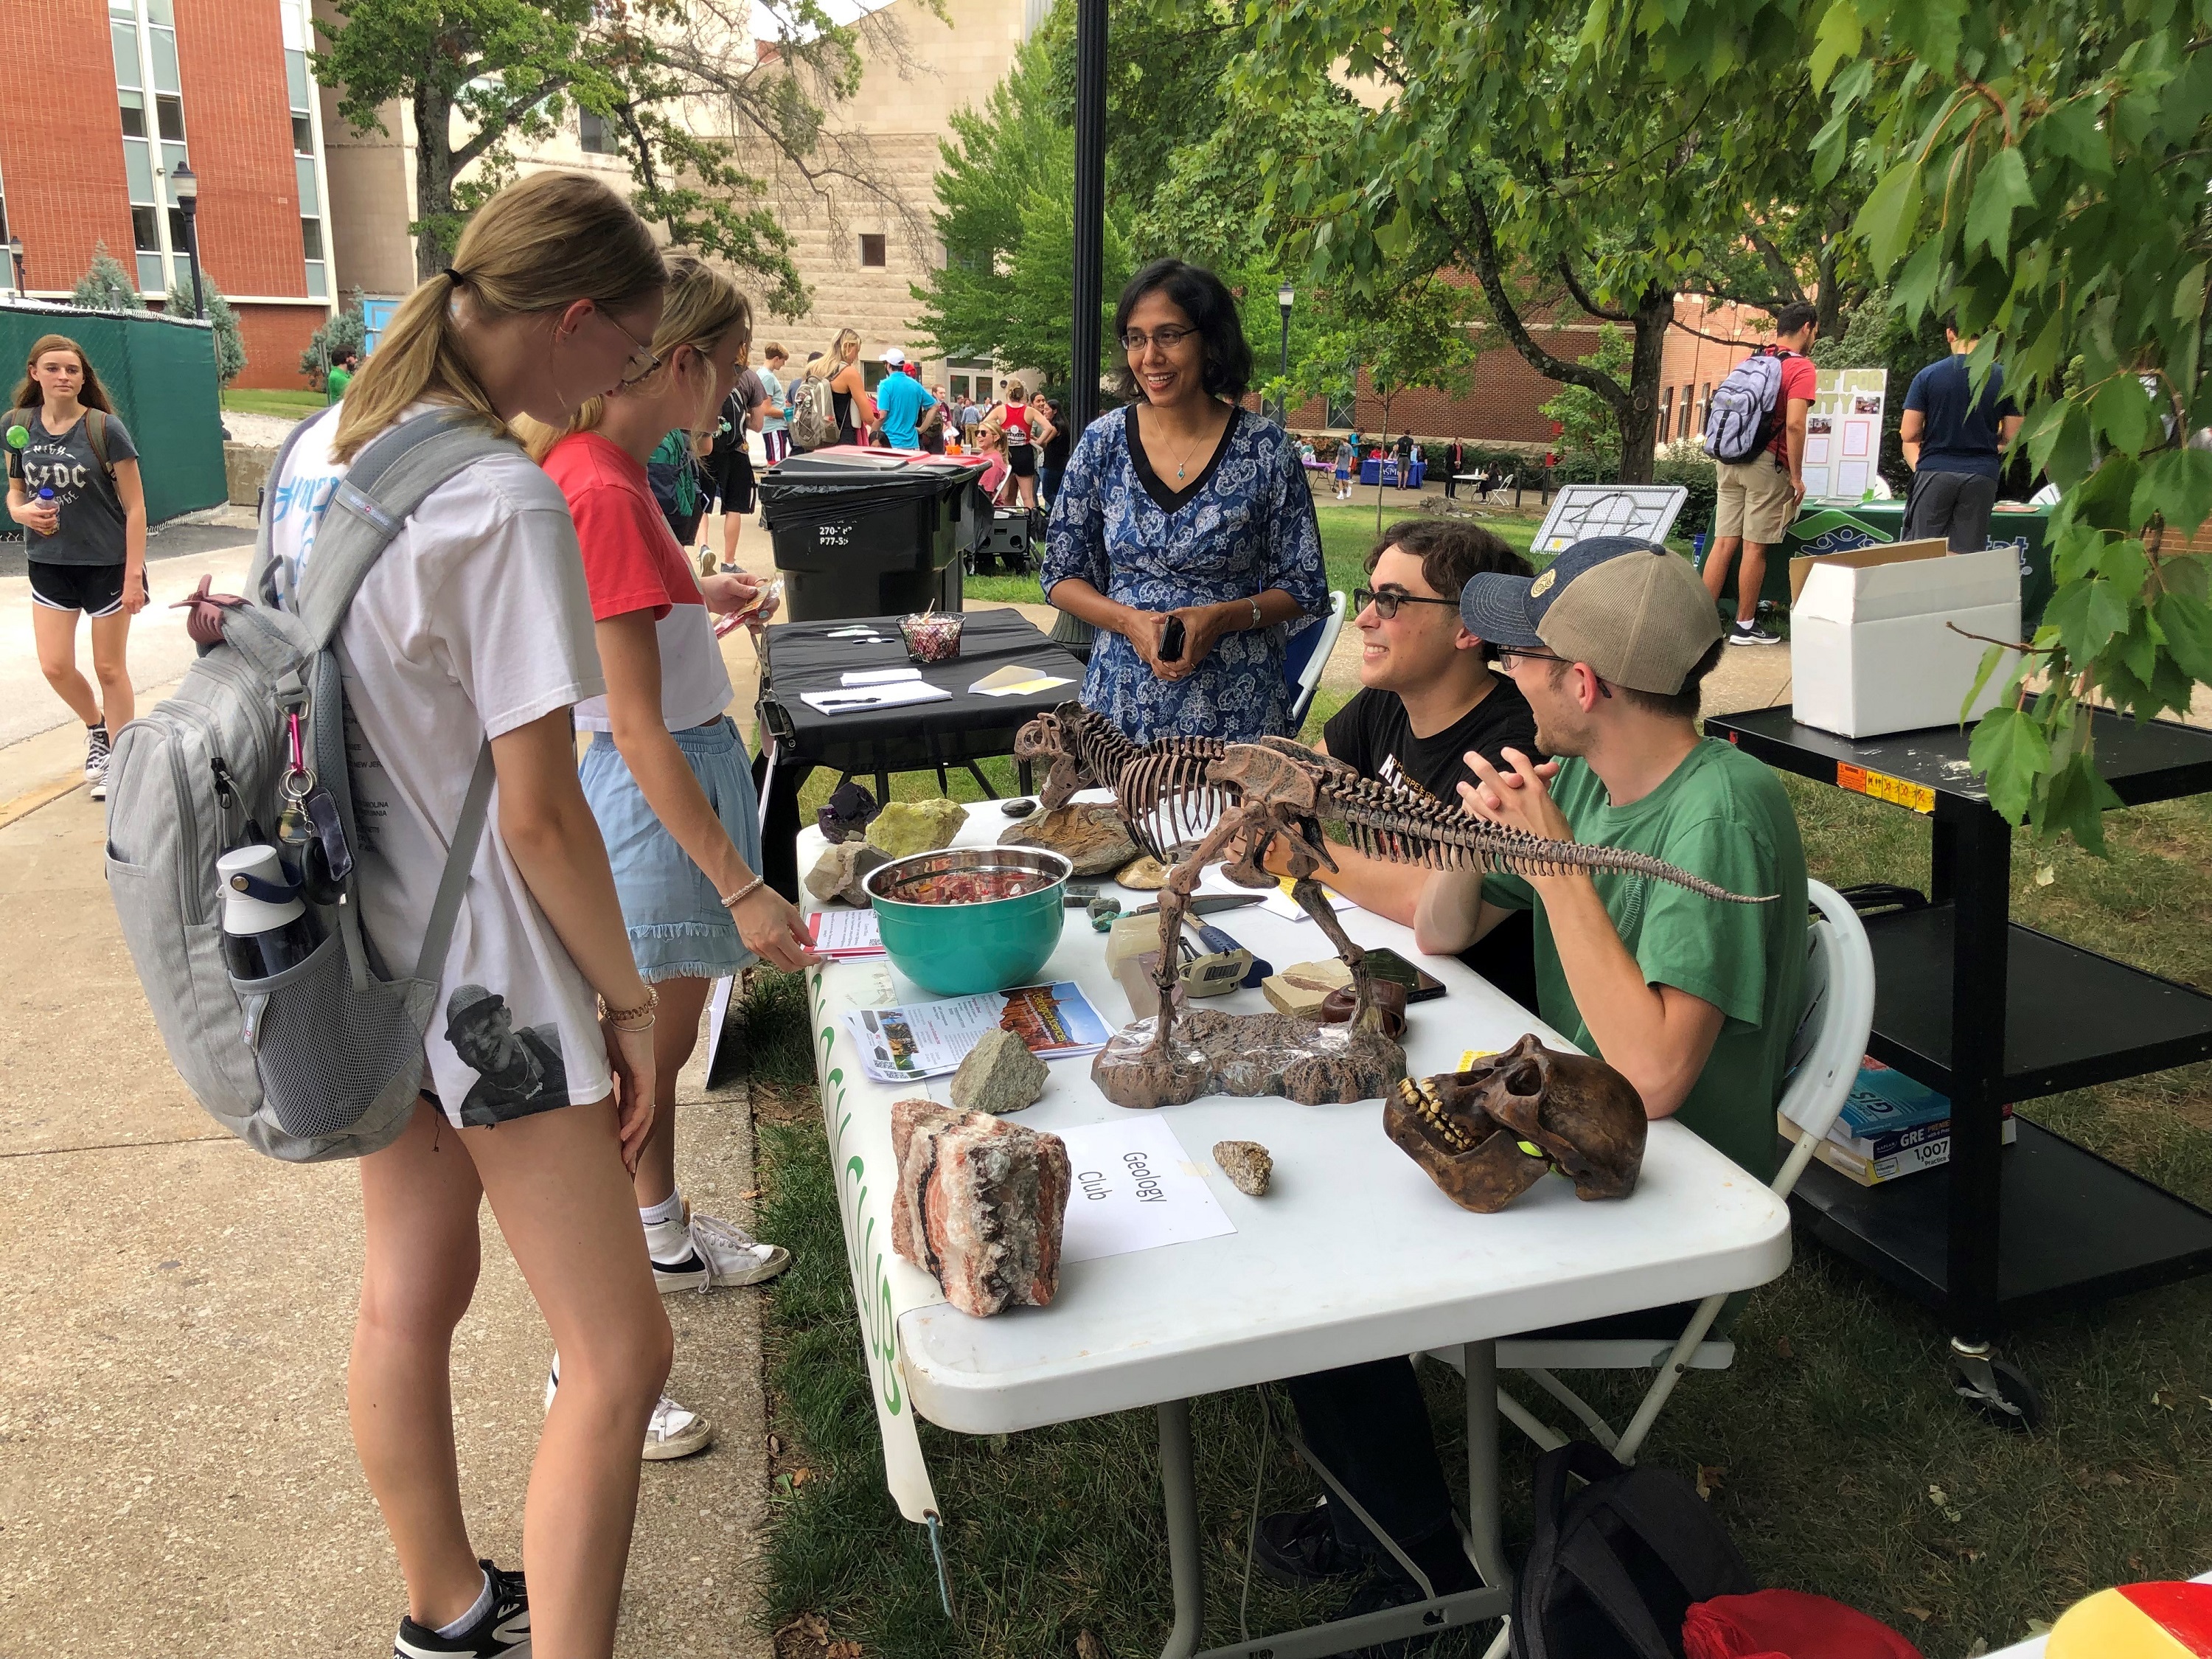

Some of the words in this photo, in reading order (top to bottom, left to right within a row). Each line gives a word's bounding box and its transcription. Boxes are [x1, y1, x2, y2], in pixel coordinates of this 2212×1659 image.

[1843, 370, 1885, 392] FOR
[1850, 1091, 1893, 1113] GIS
[1927, 1119, 1951, 1133] PREMIE
[1877, 1142, 1896, 1151] KAPLAN
[1900, 1129, 1924, 1147] GRE
[1914, 1141, 1948, 1161] 1,007
[1924, 1157, 1947, 1166] Practice
[1077, 1171, 1113, 1200] Club
[1123, 1152, 1167, 1203] Geology
